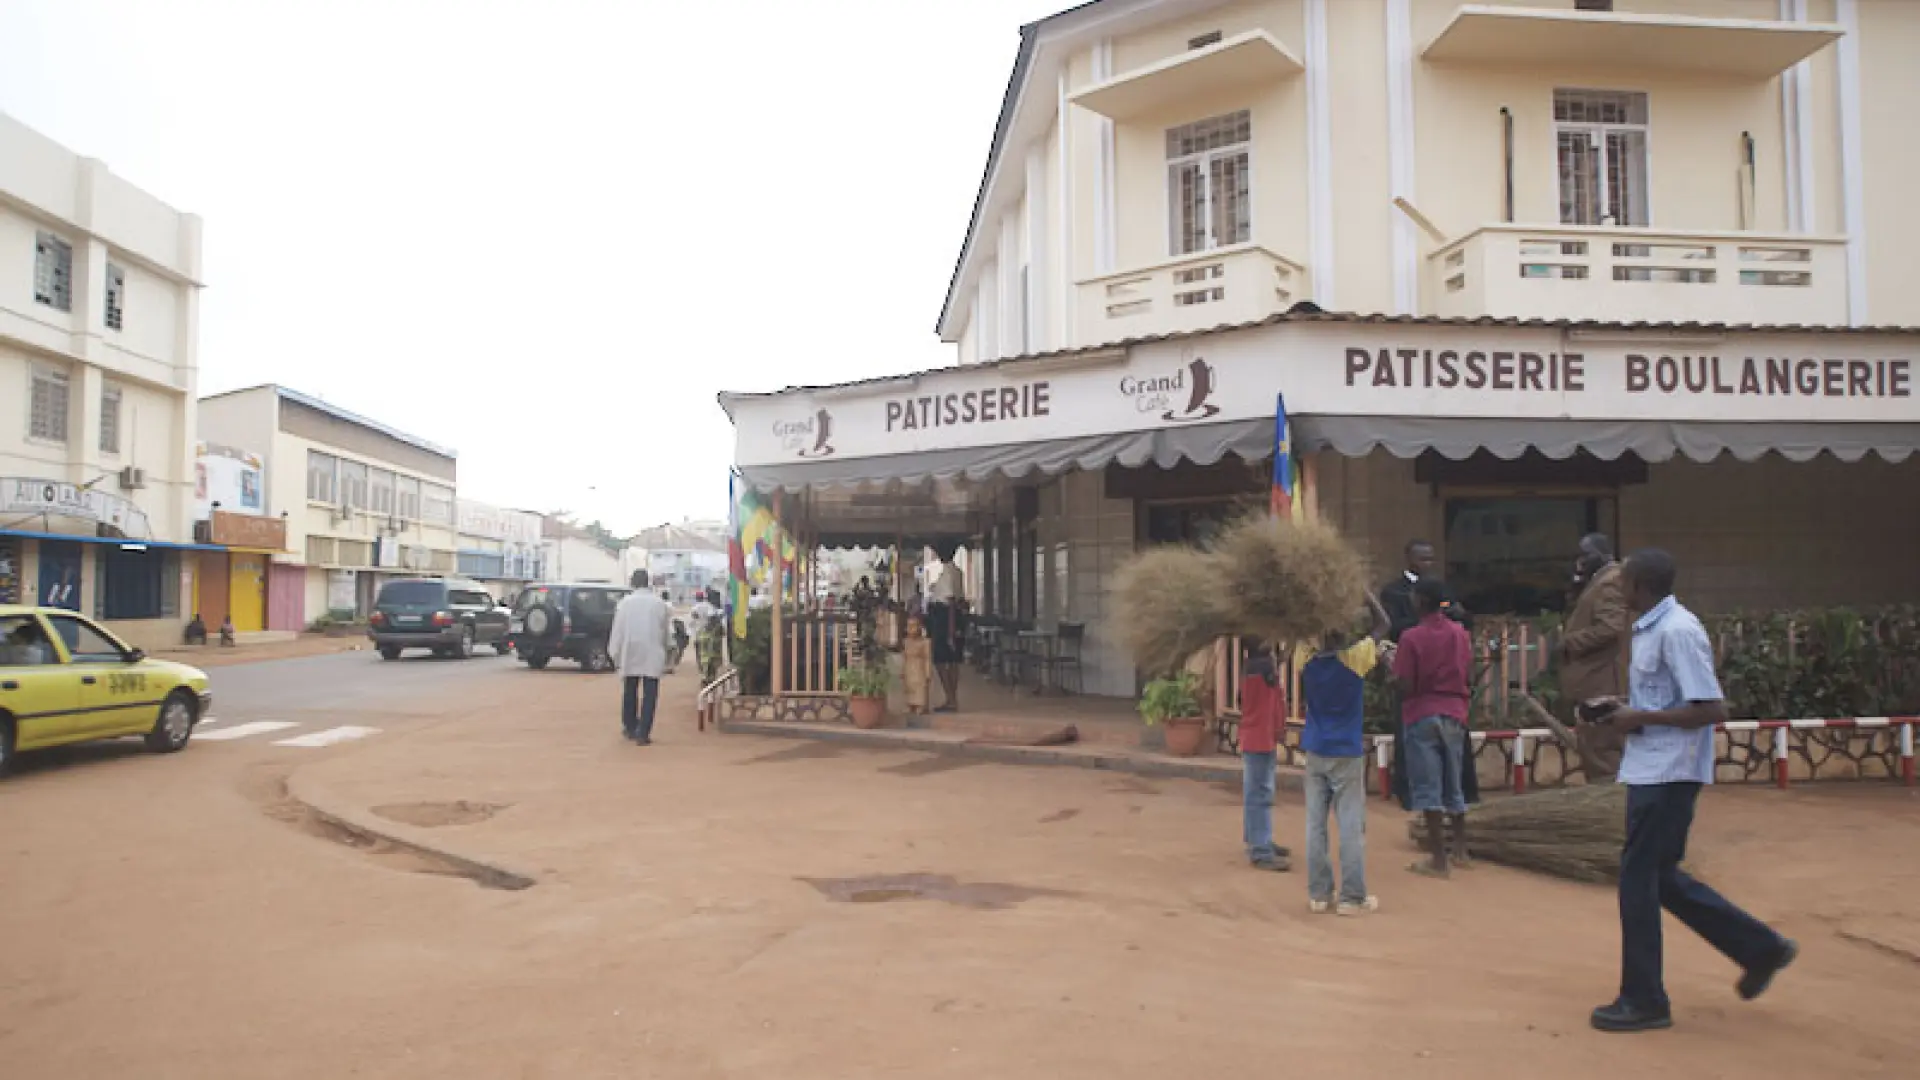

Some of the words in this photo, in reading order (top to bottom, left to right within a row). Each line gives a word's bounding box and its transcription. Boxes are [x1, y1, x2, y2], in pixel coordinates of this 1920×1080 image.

[1121, 369, 1184, 395] Grand
[1345, 347, 1585, 392] PATISSERIE
[1625, 354, 1911, 396] BOULANGERIE
[887, 381, 1050, 432] PATISSERIE
